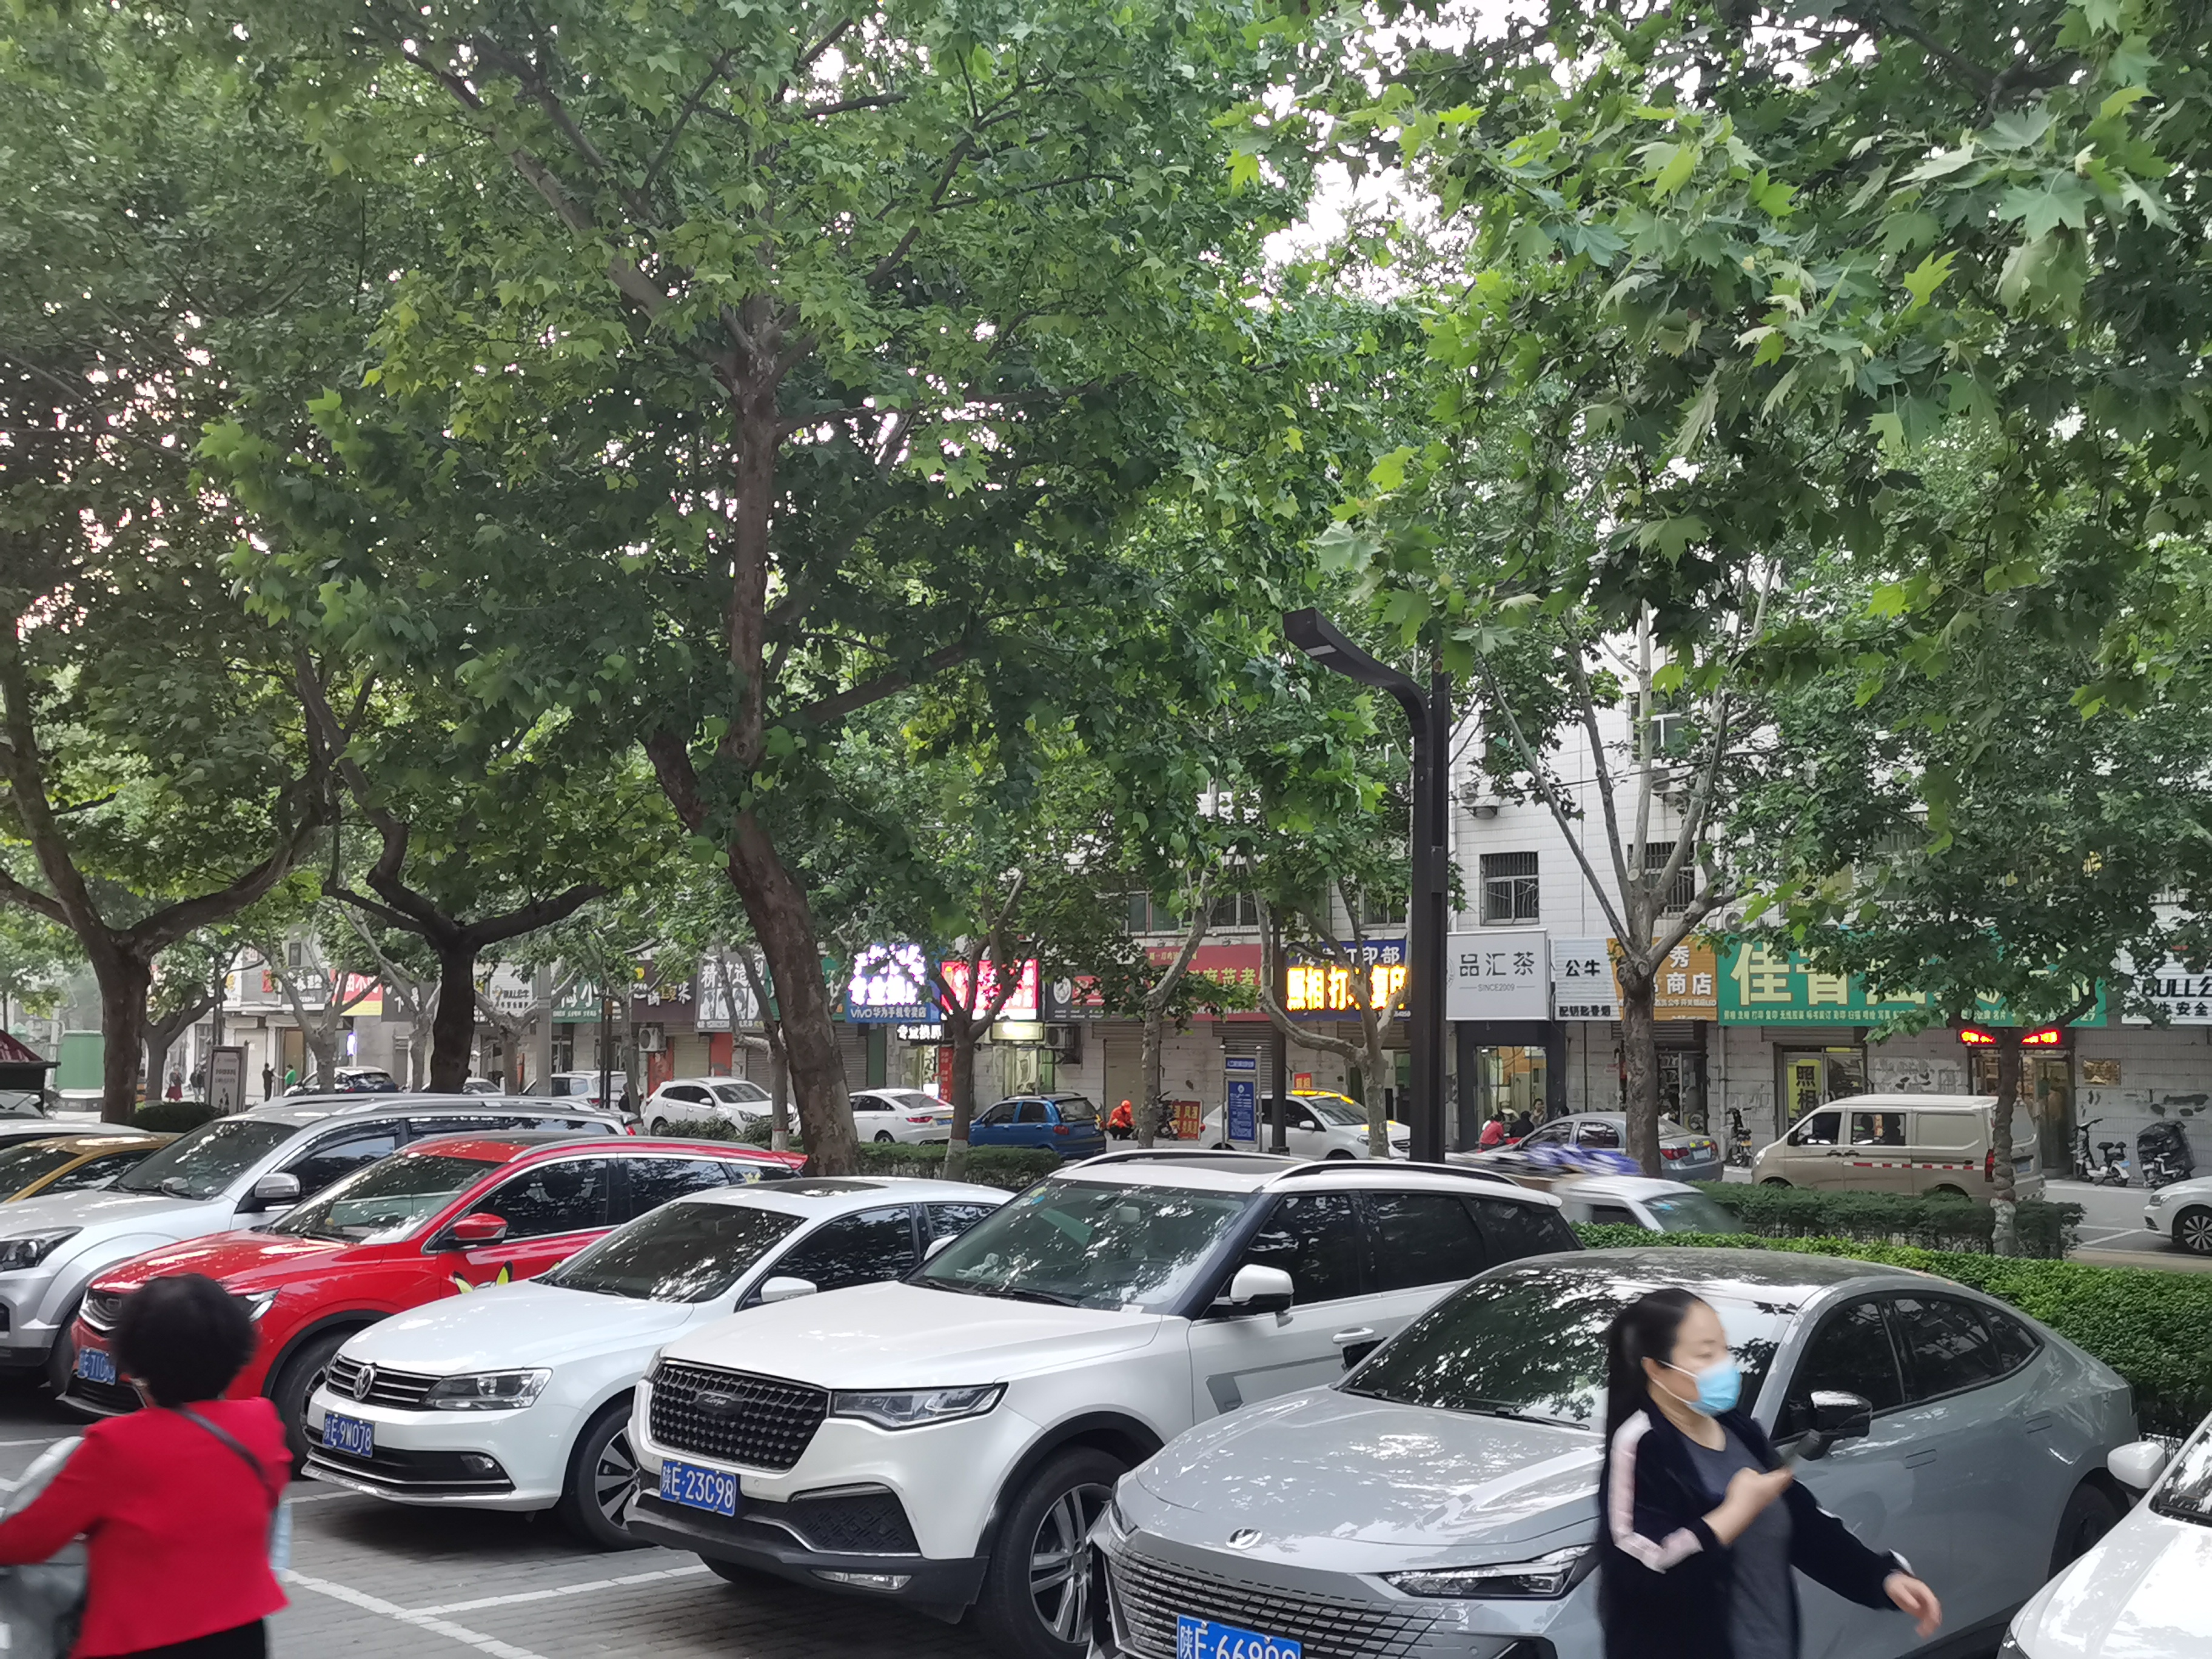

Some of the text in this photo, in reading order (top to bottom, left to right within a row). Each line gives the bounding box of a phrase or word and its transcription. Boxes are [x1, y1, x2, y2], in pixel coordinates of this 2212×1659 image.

[1460, 951, 1535, 977] 品汇茶
[1566, 959, 1601, 977] 公牛
[1669, 945, 1690, 968] 秀
[1286, 965, 1407, 1011] 照相打复印
[1654, 972, 1712, 995] 商店
[662, 1465, 734, 1509] 陕E·23C98
